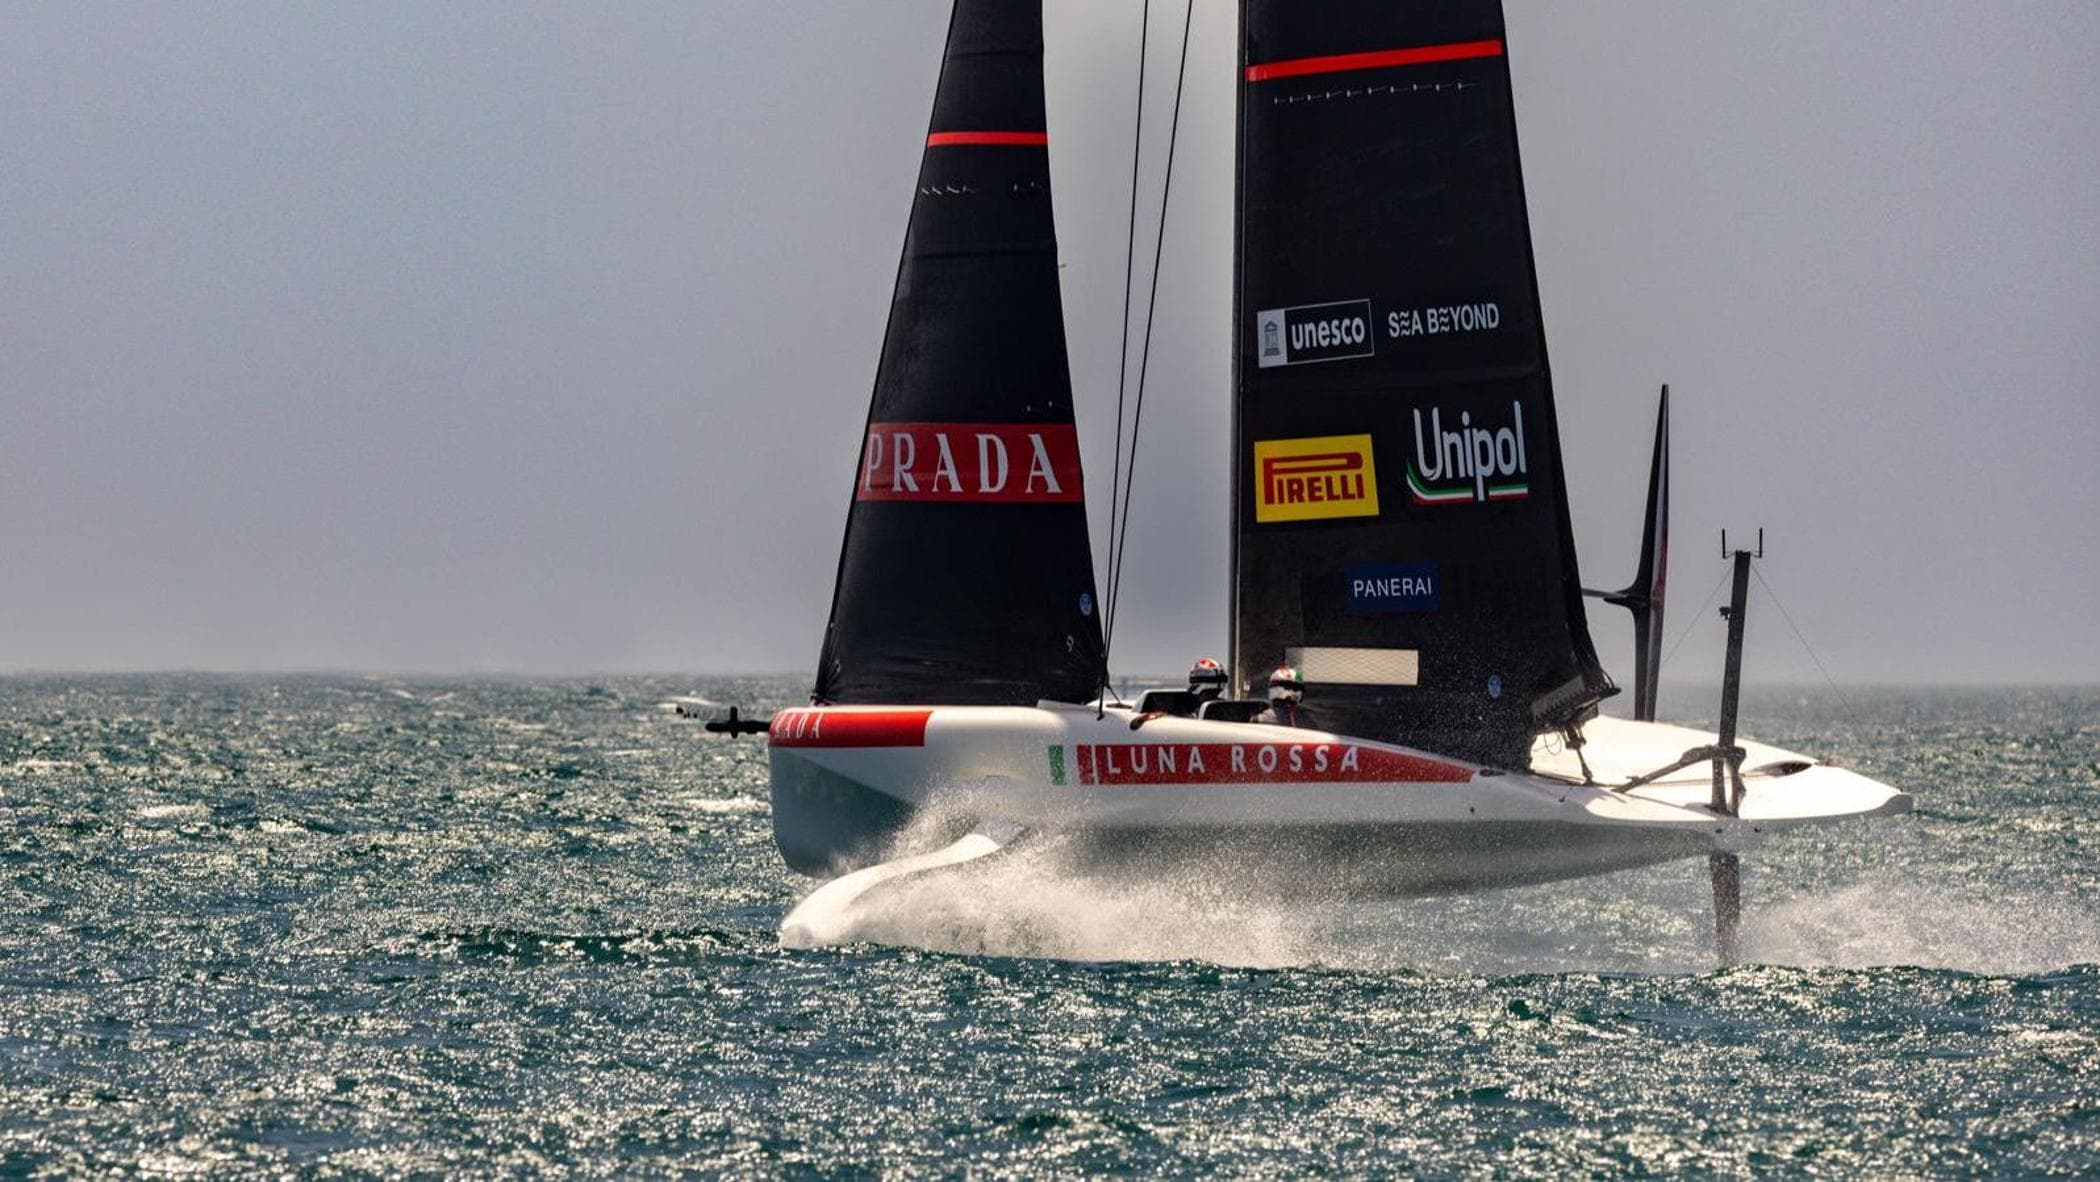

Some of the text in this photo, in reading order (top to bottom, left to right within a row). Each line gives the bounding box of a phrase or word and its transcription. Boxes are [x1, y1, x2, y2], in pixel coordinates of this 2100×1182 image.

[1291, 317, 1365, 350] unesco
[865, 433, 1063, 493] PRADA
[1413, 400, 1527, 502] Unipol
[1263, 452, 1365, 505] PIRELLI
[1353, 577, 1432, 598] PANERAI
[1105, 744, 1360, 775] LUNA ROSSA
